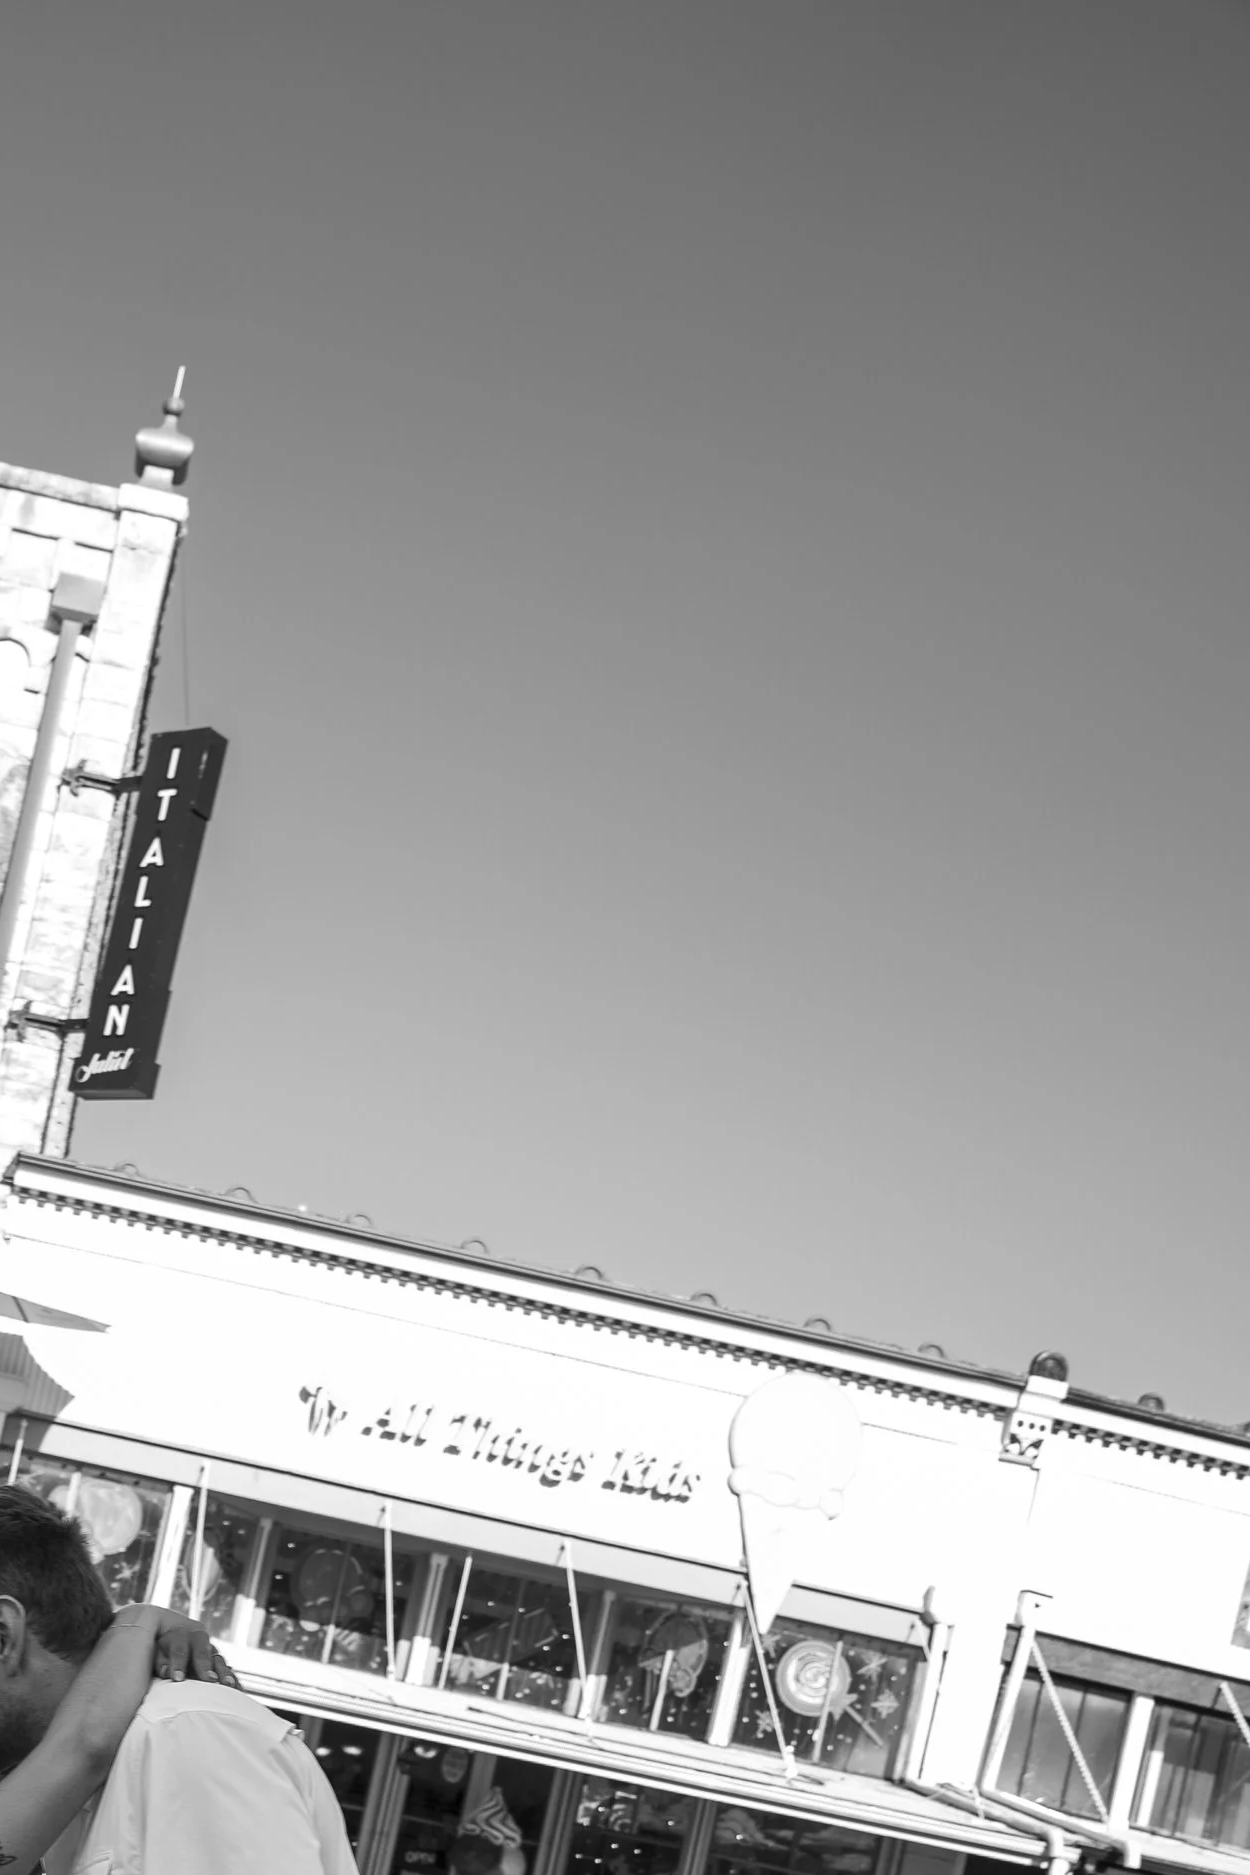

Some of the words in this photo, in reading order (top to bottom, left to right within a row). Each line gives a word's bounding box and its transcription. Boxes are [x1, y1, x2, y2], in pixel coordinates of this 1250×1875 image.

[102, 747, 182, 1036] ITALIAN
[361, 1402, 433, 1446] All
[443, 1414, 594, 1487] Things
[601, 1448, 700, 1503] Kids
